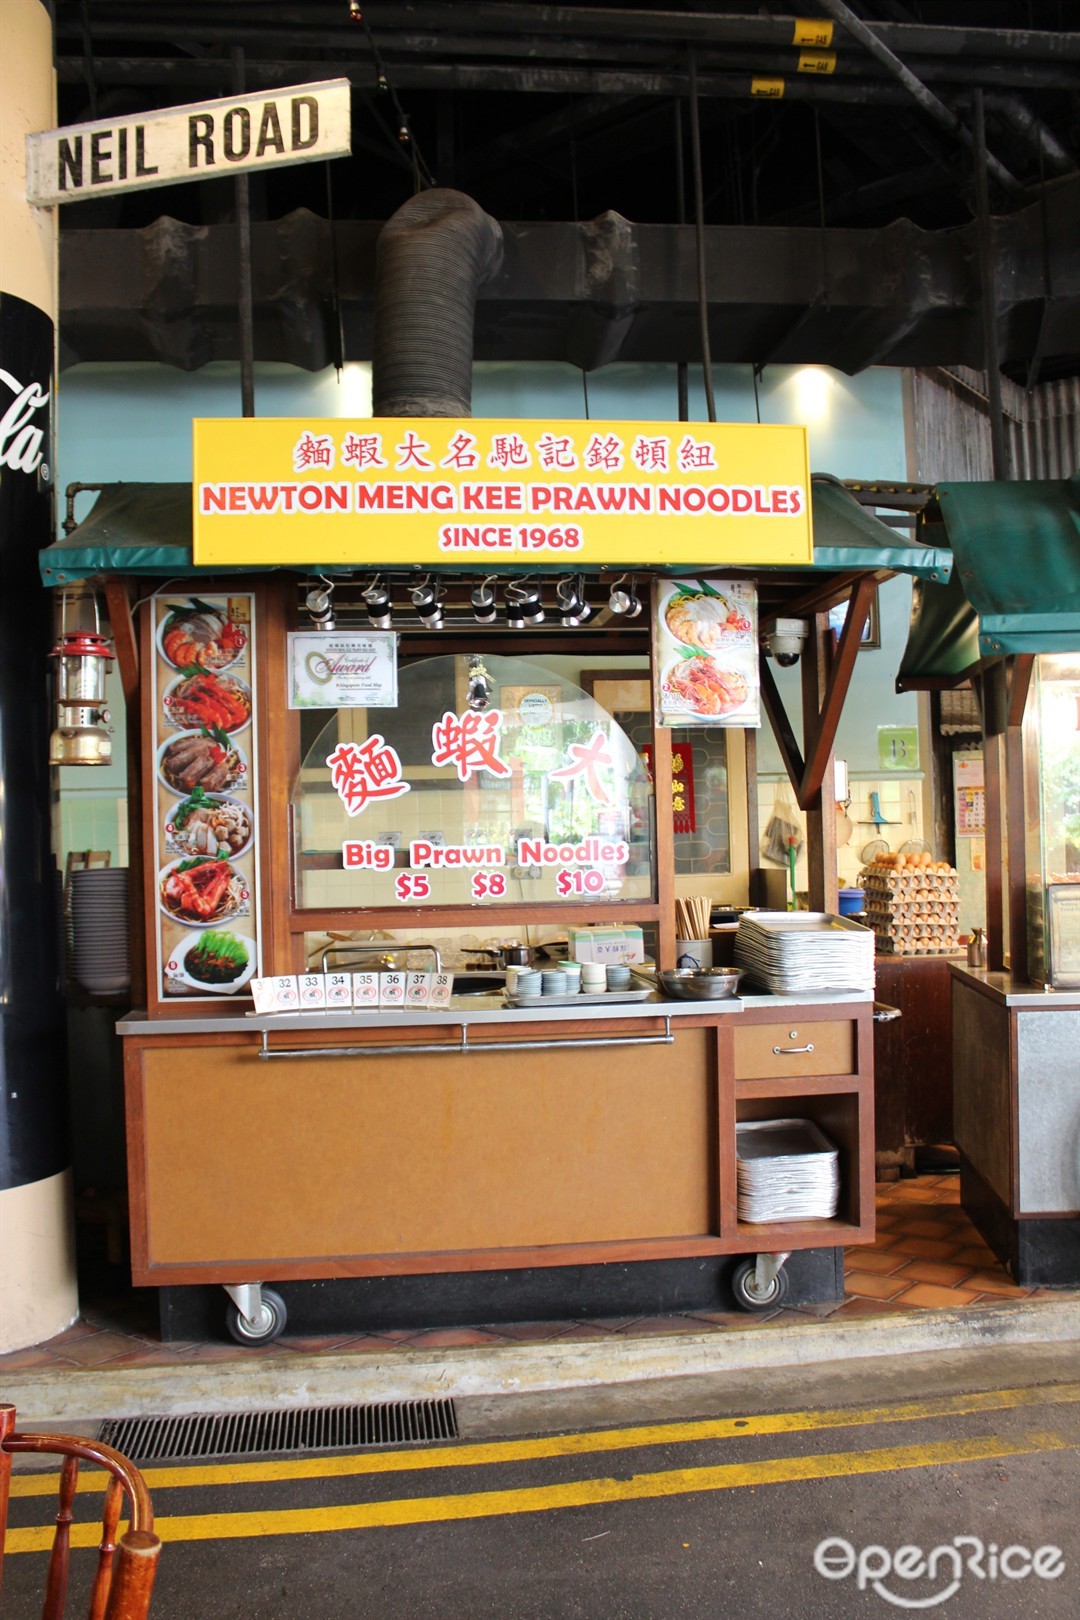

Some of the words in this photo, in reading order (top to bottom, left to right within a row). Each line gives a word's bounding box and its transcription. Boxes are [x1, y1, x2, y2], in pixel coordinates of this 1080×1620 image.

[58, 125, 158, 190] NEIL
[188, 96, 319, 168] ROAD
[203, 485, 348, 511] NEWTON
[358, 485, 453, 509] MENG
[463, 486, 522, 510] KEE
[531, 486, 650, 511] PRAWN
[659, 487, 801, 514] NOODLES
[442, 527, 512, 547] SINCE
[519, 527, 580, 548] 1968
[315, 654, 378, 673] Award
[892, 739, 906, 758] B
[346, 843, 390, 868] Big
[413, 843, 501, 865] Prawn
[521, 840, 625, 863] Noodles
[397, 873, 429, 899] $5
[473, 872, 505, 897] $8
[558, 869, 604, 895] $10
[279, 978, 291, 988] 32
[305, 977, 318, 987] 33
[331, 975, 345, 986] 34
[360, 975, 373, 985] 35
[386, 974, 400, 984] 36
[413, 974, 426, 985] 37
[436, 975, 448, 986] 38
